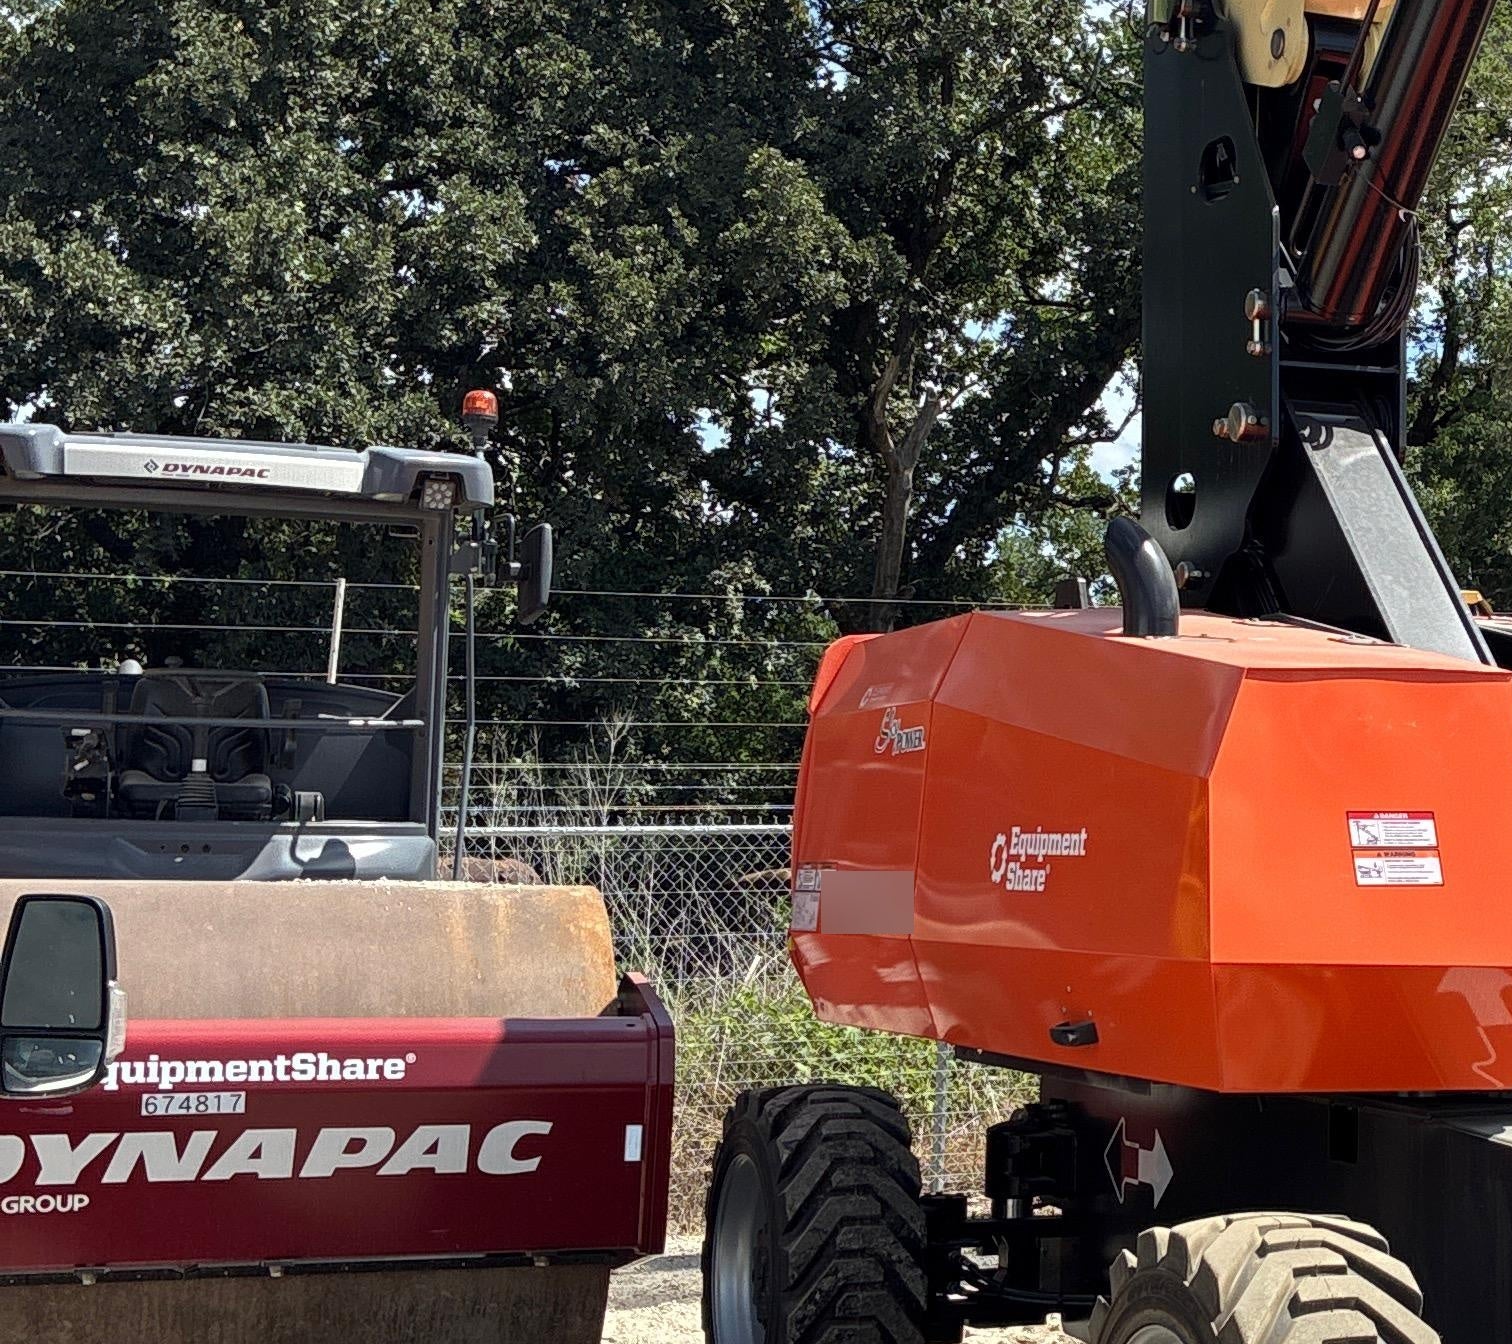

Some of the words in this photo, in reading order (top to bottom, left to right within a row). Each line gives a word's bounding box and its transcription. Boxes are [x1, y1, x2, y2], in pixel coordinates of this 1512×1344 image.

[161, 462, 271, 479] DYNAPAC
[1009, 825, 1088, 863] Equipment
[1005, 861, 1047, 892] Share
[100, 1052, 407, 1091] quipmentShare
[143, 1093, 244, 1116] 674817
[1, 1193, 90, 1215] GROUP
